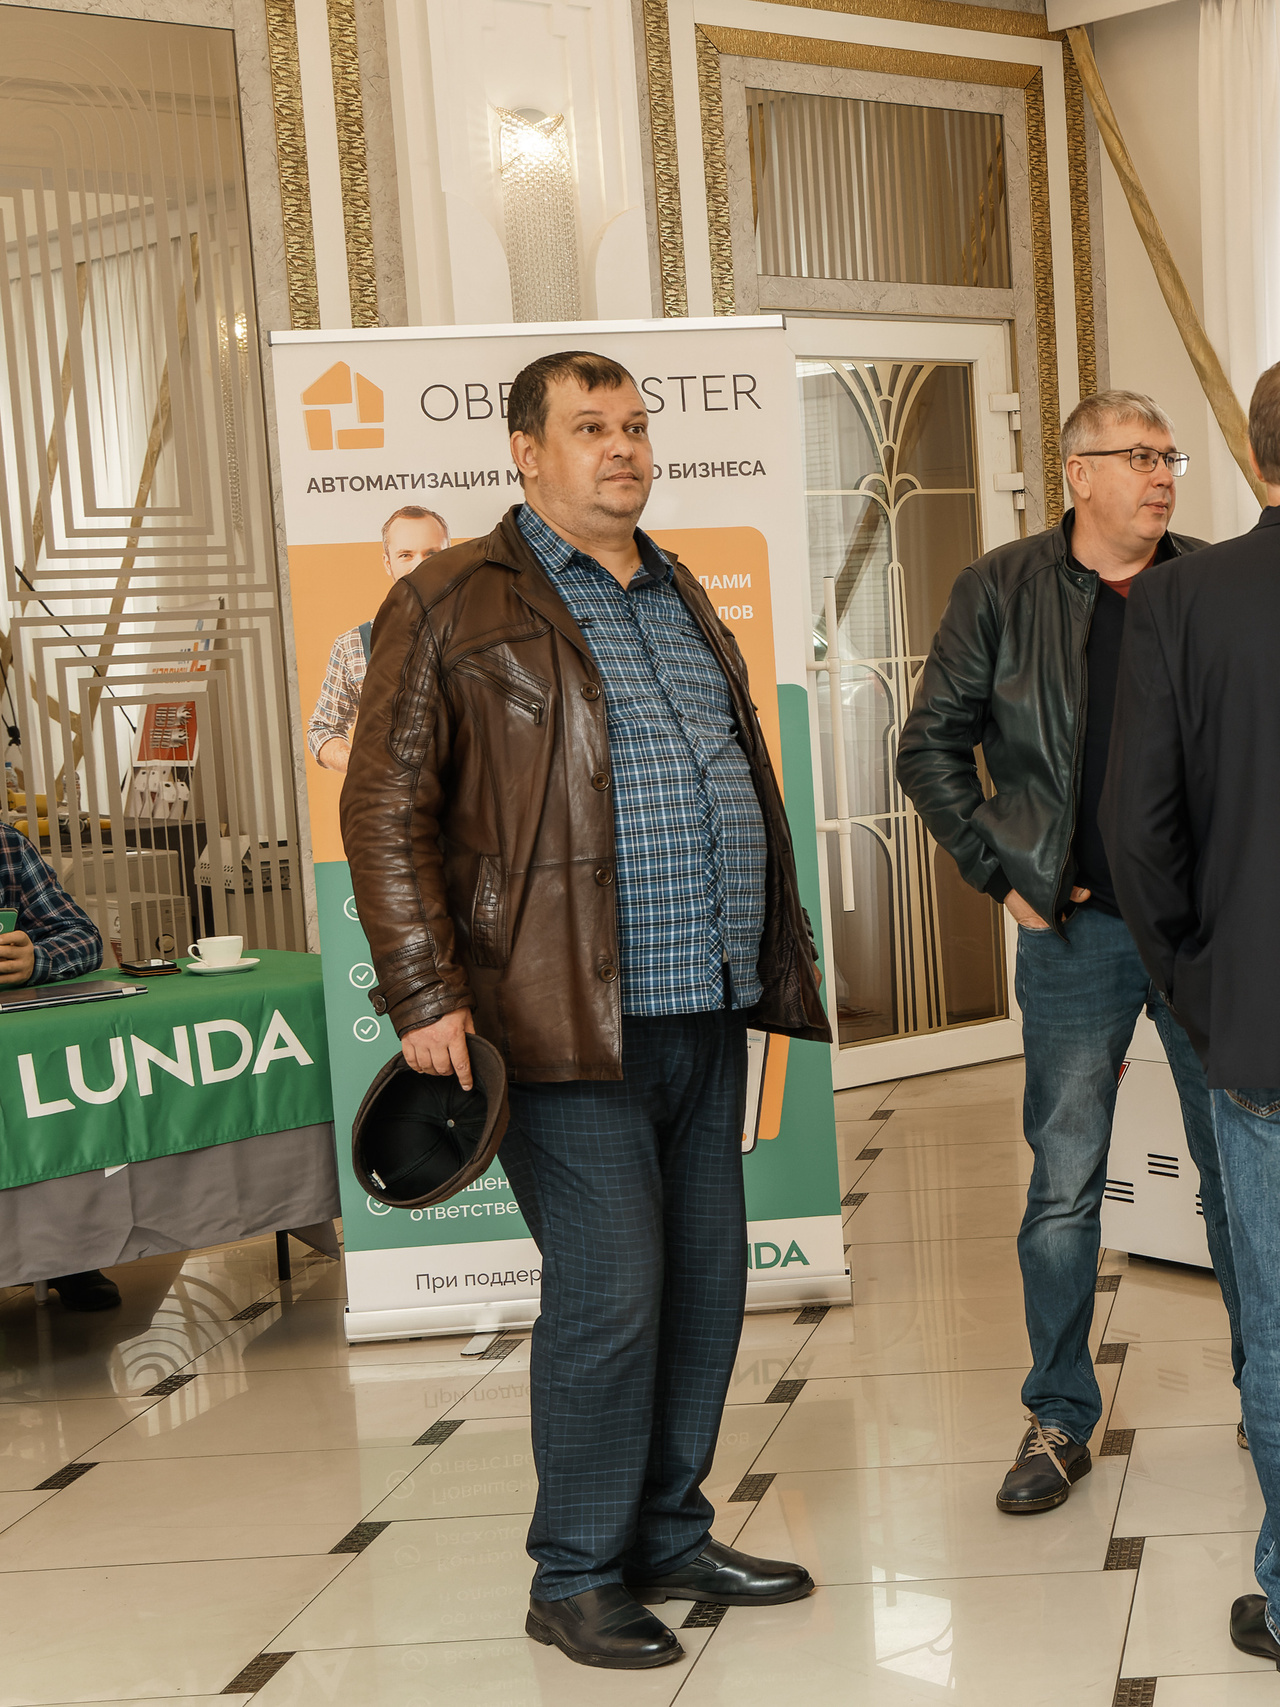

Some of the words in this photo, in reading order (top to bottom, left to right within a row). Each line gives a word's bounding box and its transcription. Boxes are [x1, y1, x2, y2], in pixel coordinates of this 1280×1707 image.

[306, 470, 500, 494] АВТОМАТИЗАЦИЯ
[668, 460, 766, 479] БИЗНЕСА
[717, 604, 754, 620] ЛОВ
[17, 1009, 315, 1119] LUNDA
[410, 1201, 519, 1222] ответстве
[748, 1239, 810, 1270] DA
[416, 1273, 458, 1293] При
[464, 1268, 542, 1287] поддер
